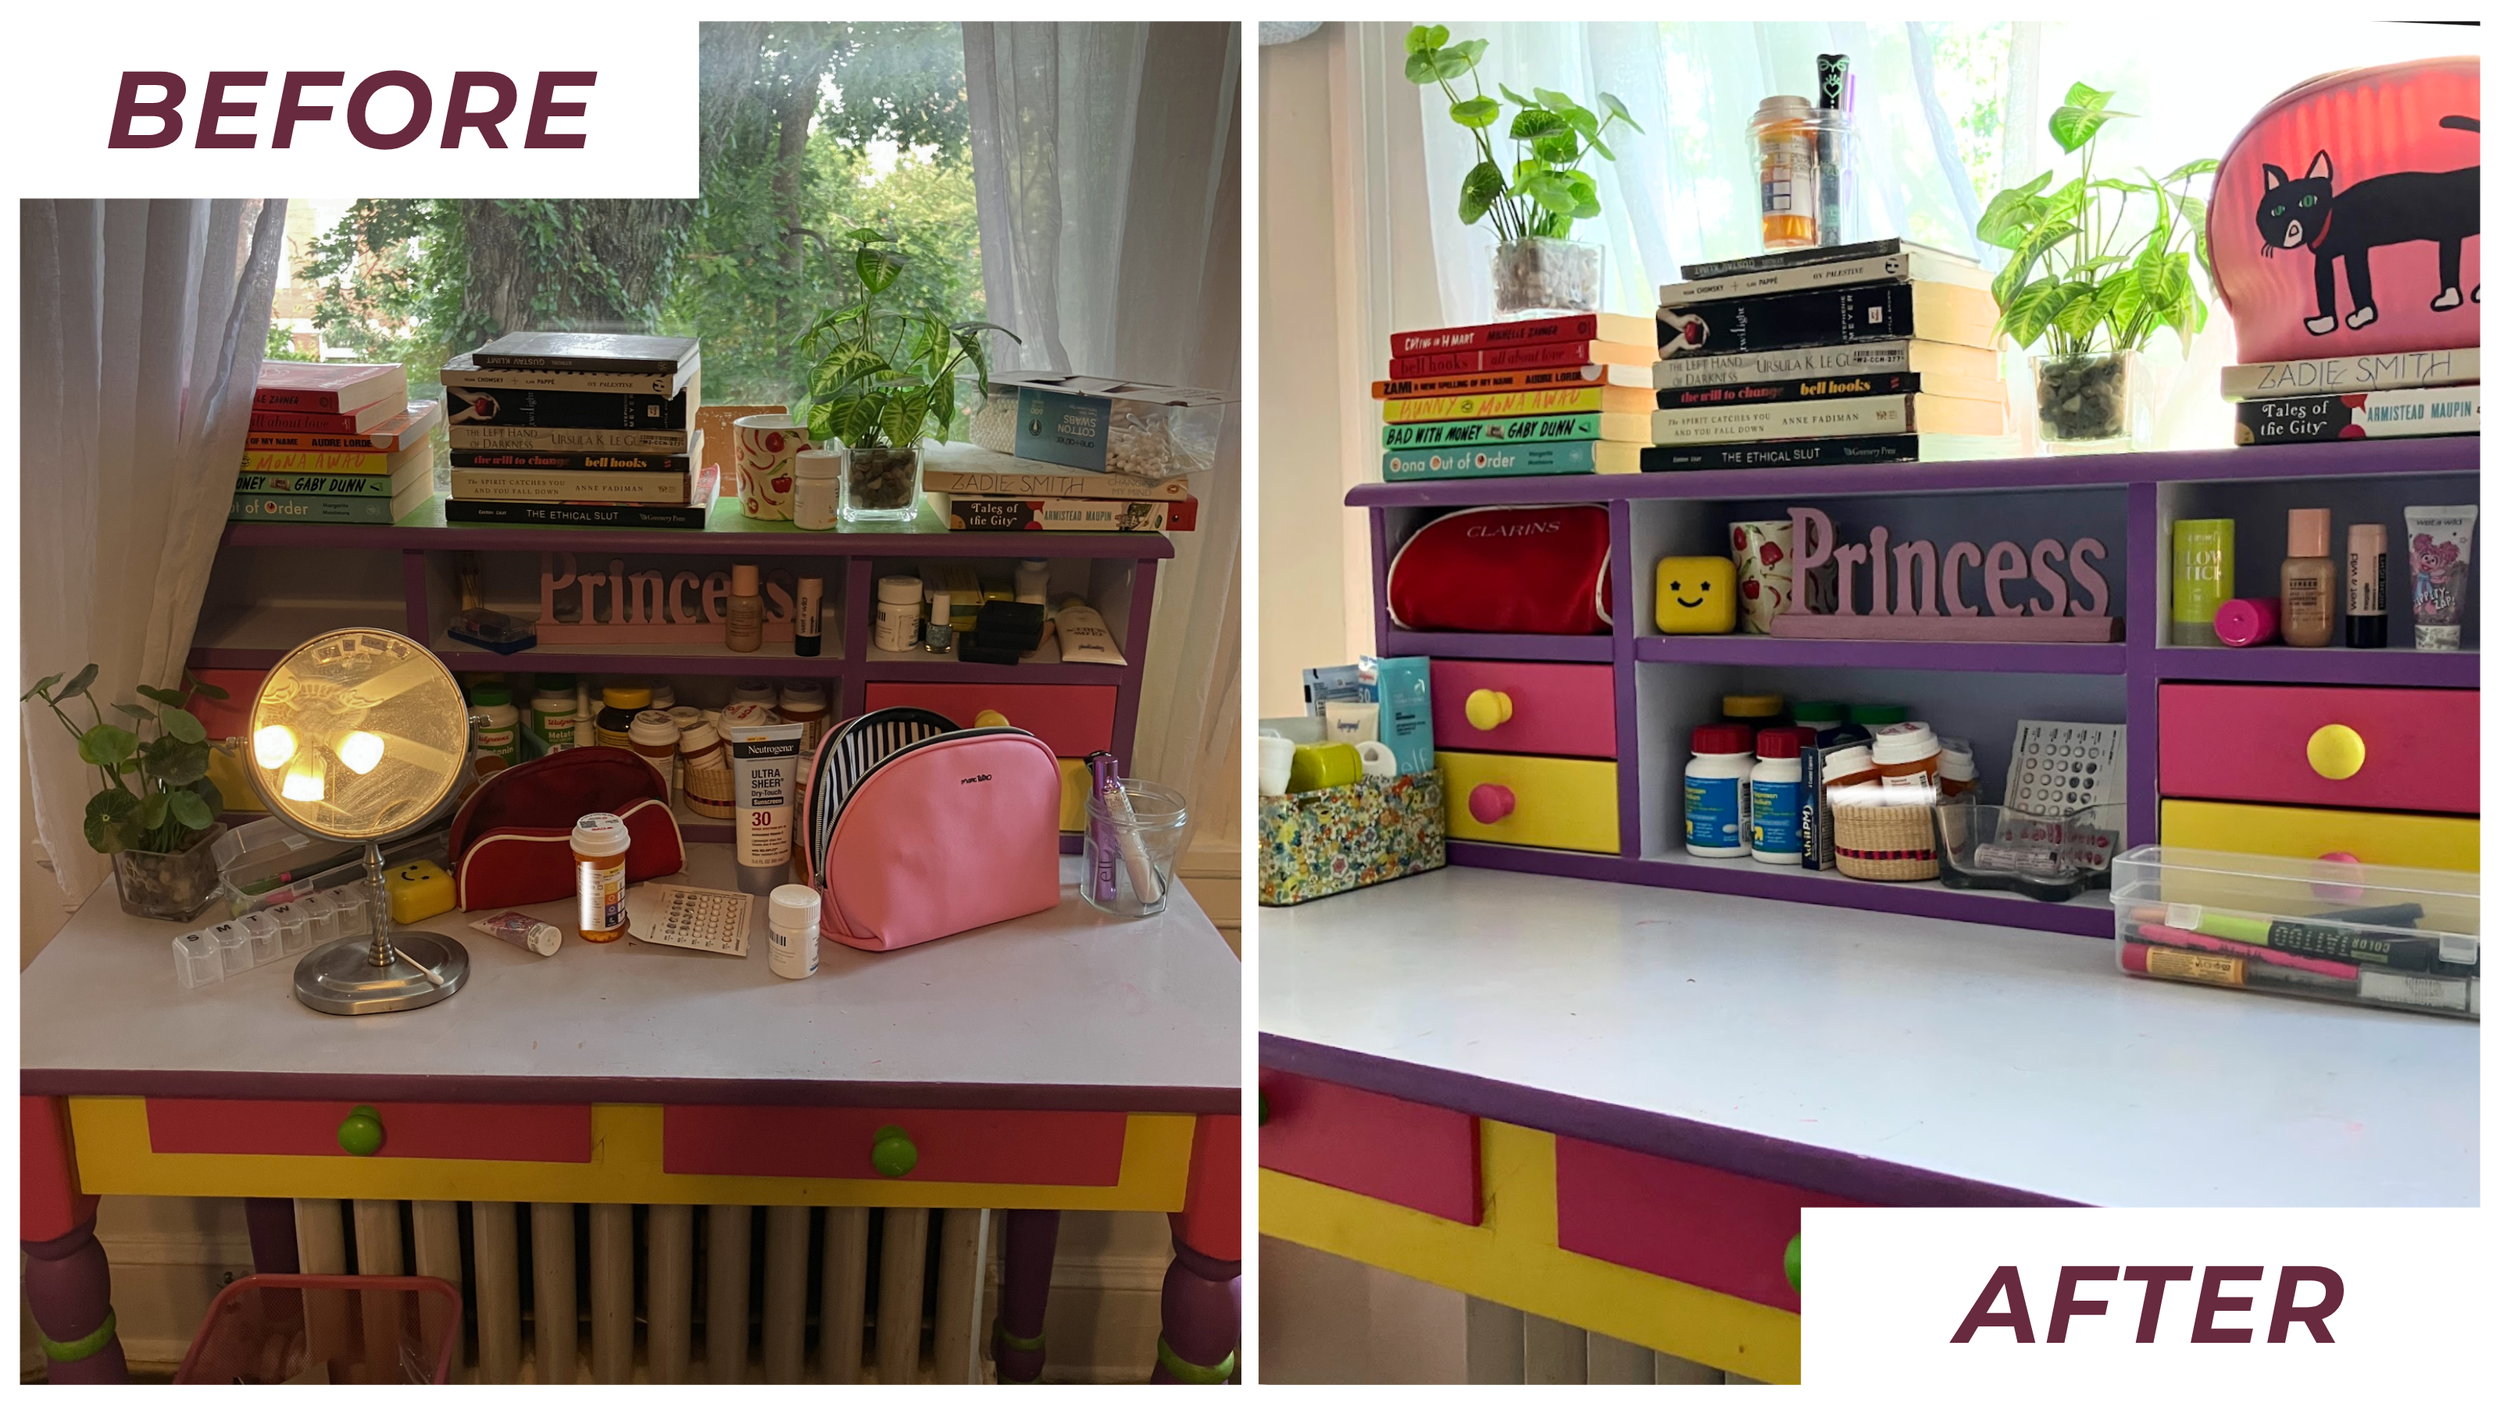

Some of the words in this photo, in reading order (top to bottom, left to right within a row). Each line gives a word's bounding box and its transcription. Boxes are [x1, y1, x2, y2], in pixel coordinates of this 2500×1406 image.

[1697, 285, 1724, 294] CHOMSKY
[1826, 268, 1864, 278] PALESTINE
[1487, 328, 1524, 341] MICHELLE
[1730, 308, 1748, 352] twilight
[1405, 336, 1431, 351] CRYING
[1442, 335, 1449, 346] H
[1451, 333, 1474, 346] MART
[1506, 349, 1539, 364] about
[1541, 348, 1565, 361] love
[1401, 358, 1424, 374] bell
[1429, 354, 1468, 372] hooks
[1669, 362, 1683, 372] THE
[1685, 360, 1708, 371] LEFT
[1711, 358, 1742, 369] HAND
[1756, 359, 1801, 373] URSULA
[1806, 358, 1817, 370] K.
[1820, 357, 1832, 368] LE
[1836, 354, 1850, 368] GU
[1525, 374, 1552, 384] AUDRE
[1555, 372, 1581, 382] LORDE
[2258, 361, 2347, 390] ZADIE
[2356, 352, 2450, 389] SMITH
[1384, 381, 1412, 395] ZAMI
[1420, 382, 1436, 390] NEW
[1438, 380, 1468, 389] SPELLING
[1493, 377, 1514, 385] NAME
[1685, 373, 1738, 385] DARKNESS
[1800, 382, 1826, 396] bell
[1828, 378, 1871, 393] hooks
[1532, 390, 1581, 408] AWAD
[1681, 392, 1699, 403] the
[1700, 390, 1722, 401] will
[1724, 390, 1735, 400] to
[519, 392, 537, 426] twilight
[1400, 397, 1458, 418] BUNNY
[2262, 404, 2306, 418] Tales
[2313, 401, 2329, 414] of
[2367, 404, 2425, 422] ARMISTEAD
[2431, 401, 2471, 417] MAUPIN
[267, 416, 301, 428] about
[305, 417, 329, 429] love
[1063, 415, 1096, 427] SWABS
[1682, 416, 1708, 425] SPIRIT
[1712, 414, 1750, 423] CATCHES
[1754, 413, 1771, 421] YOU
[1782, 416, 1807, 425] ANNE
[1812, 413, 1859, 424] FADIMAN
[467, 429, 481, 437] THE
[483, 427, 505, 437] LEFT
[508, 429, 538, 438] HAND
[1058, 424, 1096, 437] COTTON
[1508, 421, 1536, 438] GABY
[1539, 419, 1576, 436] DUNN
[2261, 422, 2284, 435] the
[2289, 420, 2327, 434] City
[552, 434, 592, 446] URSULA
[597, 436, 607, 446] K.
[624, 436, 640, 446] GU
[1386, 428, 1413, 445] BAD
[1416, 427, 1442, 442] WITH
[1445, 425, 1482, 440] MONEY
[311, 439, 341, 447] AUDRE
[344, 439, 372, 448] LORDE
[483, 439, 533, 449] DARKNESS
[316, 453, 366, 468] AWAD
[474, 456, 491, 464] the
[492, 456, 512, 465] will
[515, 457, 526, 465] to
[585, 457, 607, 467] bell
[610, 458, 647, 468] hooks
[1390, 457, 1425, 473] Oona
[1430, 455, 1453, 470] Out
[1457, 453, 1471, 469] of
[1474, 452, 1515, 468] Order
[1722, 452, 1742, 463] THE
[1747, 450, 1790, 463] ETHICAL
[1793, 448, 1821, 460] SLUT
[236, 476, 265, 490] ONEY
[294, 478, 325, 491] GABY
[329, 479, 366, 492] DUNN
[951, 474, 1014, 492] ZADIE
[1020, 475, 1084, 496] SMITH
[1108, 478, 1157, 487] CHANGING
[245, 500, 260, 514] of
[264, 500, 308, 515] Order
[971, 503, 1003, 515] Tales
[1006, 504, 1018, 513] of
[527, 510, 545, 518] THE
[550, 510, 591, 520] ETHICAL
[594, 511, 619, 520] SLUT
[970, 515, 987, 525] the
[991, 515, 1017, 527] City
[1044, 510, 1082, 521] ARMISTEAD
[1086, 511, 1112, 521] MAUPIN
[1467, 520, 1560, 538] CLARINS
[1788, 508, 2109, 616] Princess
[540, 550, 794, 624] Princes
[2434, 597, 2455, 610] ZAP!
[478, 734, 509, 742] algreens
[748, 745, 793, 755] Neutrogena
[1402, 747, 1428, 774] elf
[752, 769, 780, 778] ULTRA
[752, 812, 771, 826] 30
[1803, 811, 1811, 830] PM
[216, 924, 231, 932] M
[274, 905, 290, 914] W
[2274, 926, 2349, 956] TATTOO
[2352, 938, 2390, 952] COLOR
